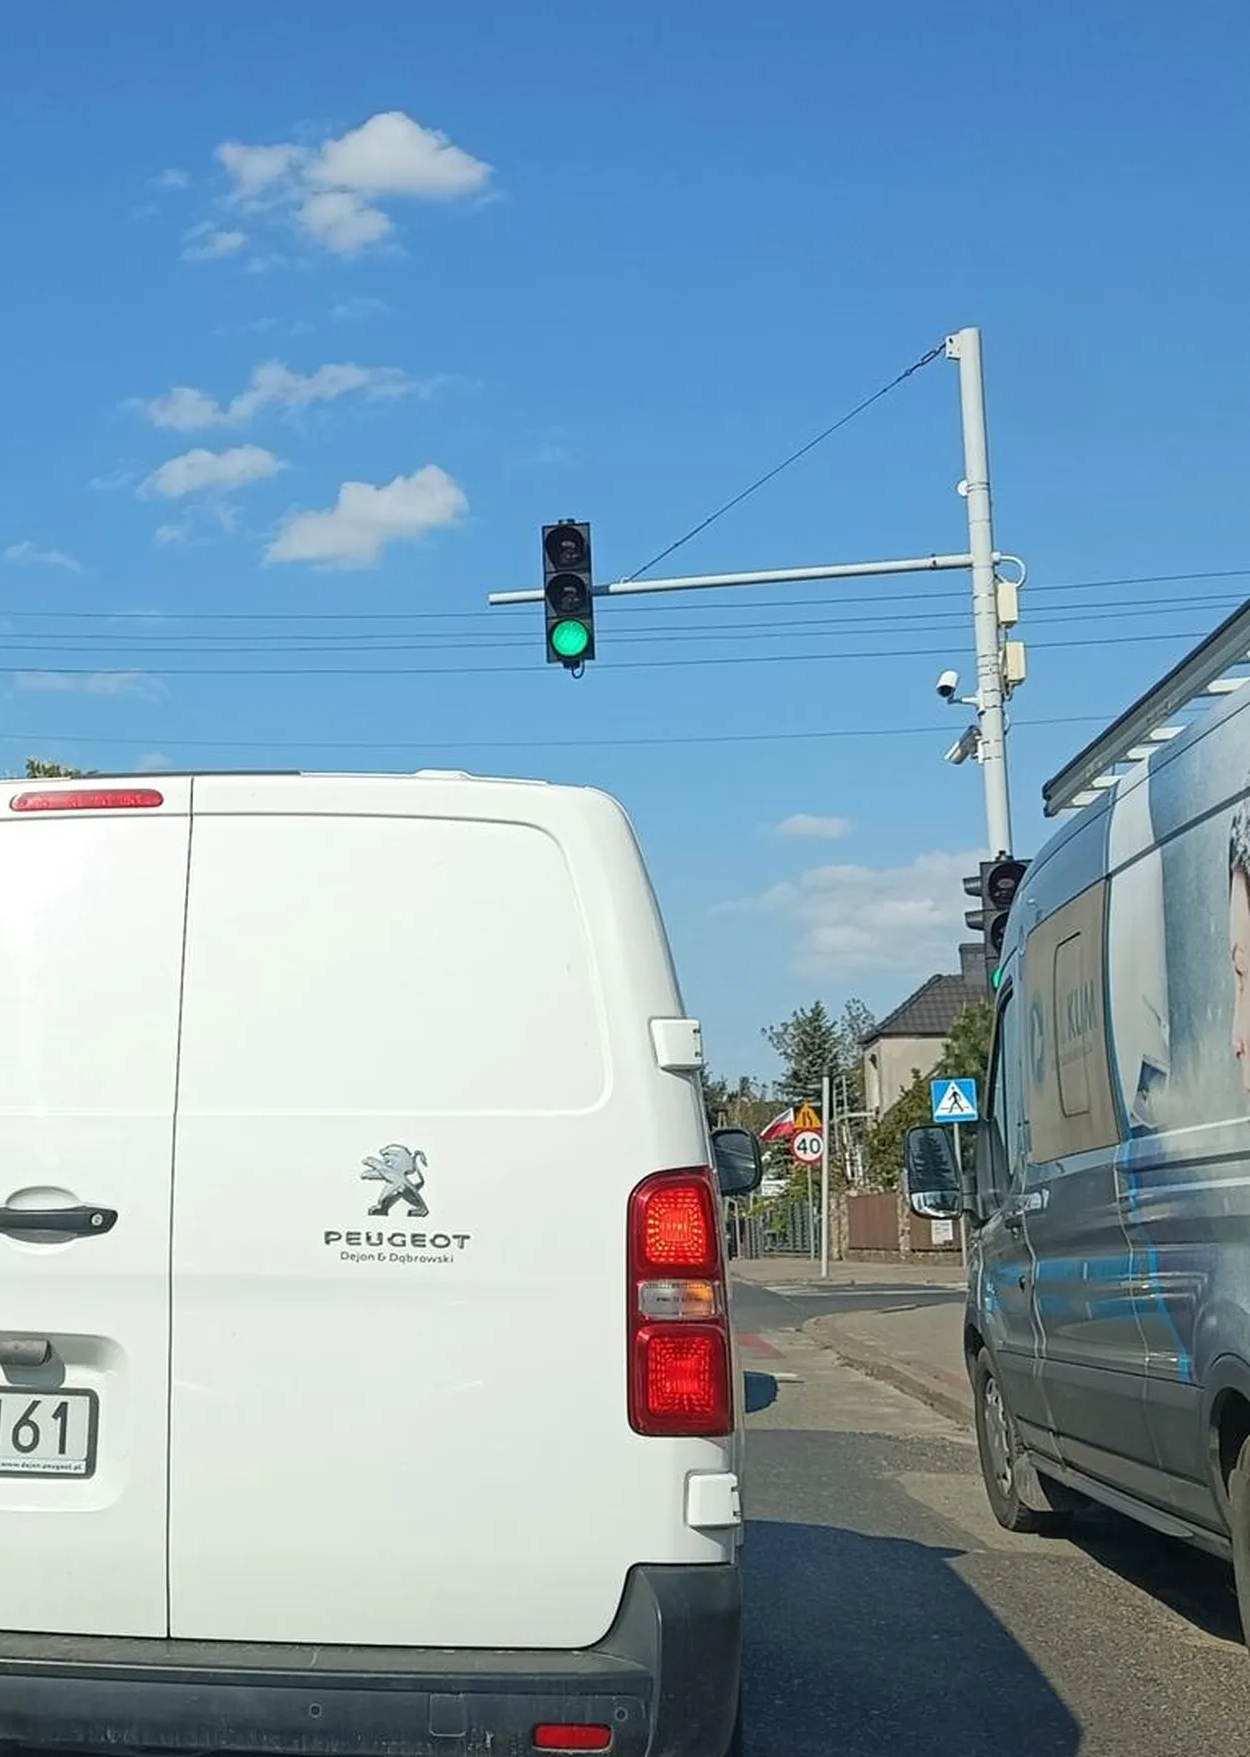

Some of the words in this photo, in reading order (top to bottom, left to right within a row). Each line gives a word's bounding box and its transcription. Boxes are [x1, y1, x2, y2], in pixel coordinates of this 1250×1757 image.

[797, 1138, 821, 1154] 40
[324, 1231, 471, 1249] PEUGEOT
[340, 1251, 375, 1263] Dejon
[377, 1252, 386, 1262] &
[389, 1252, 454, 1264] Dąbrowski
